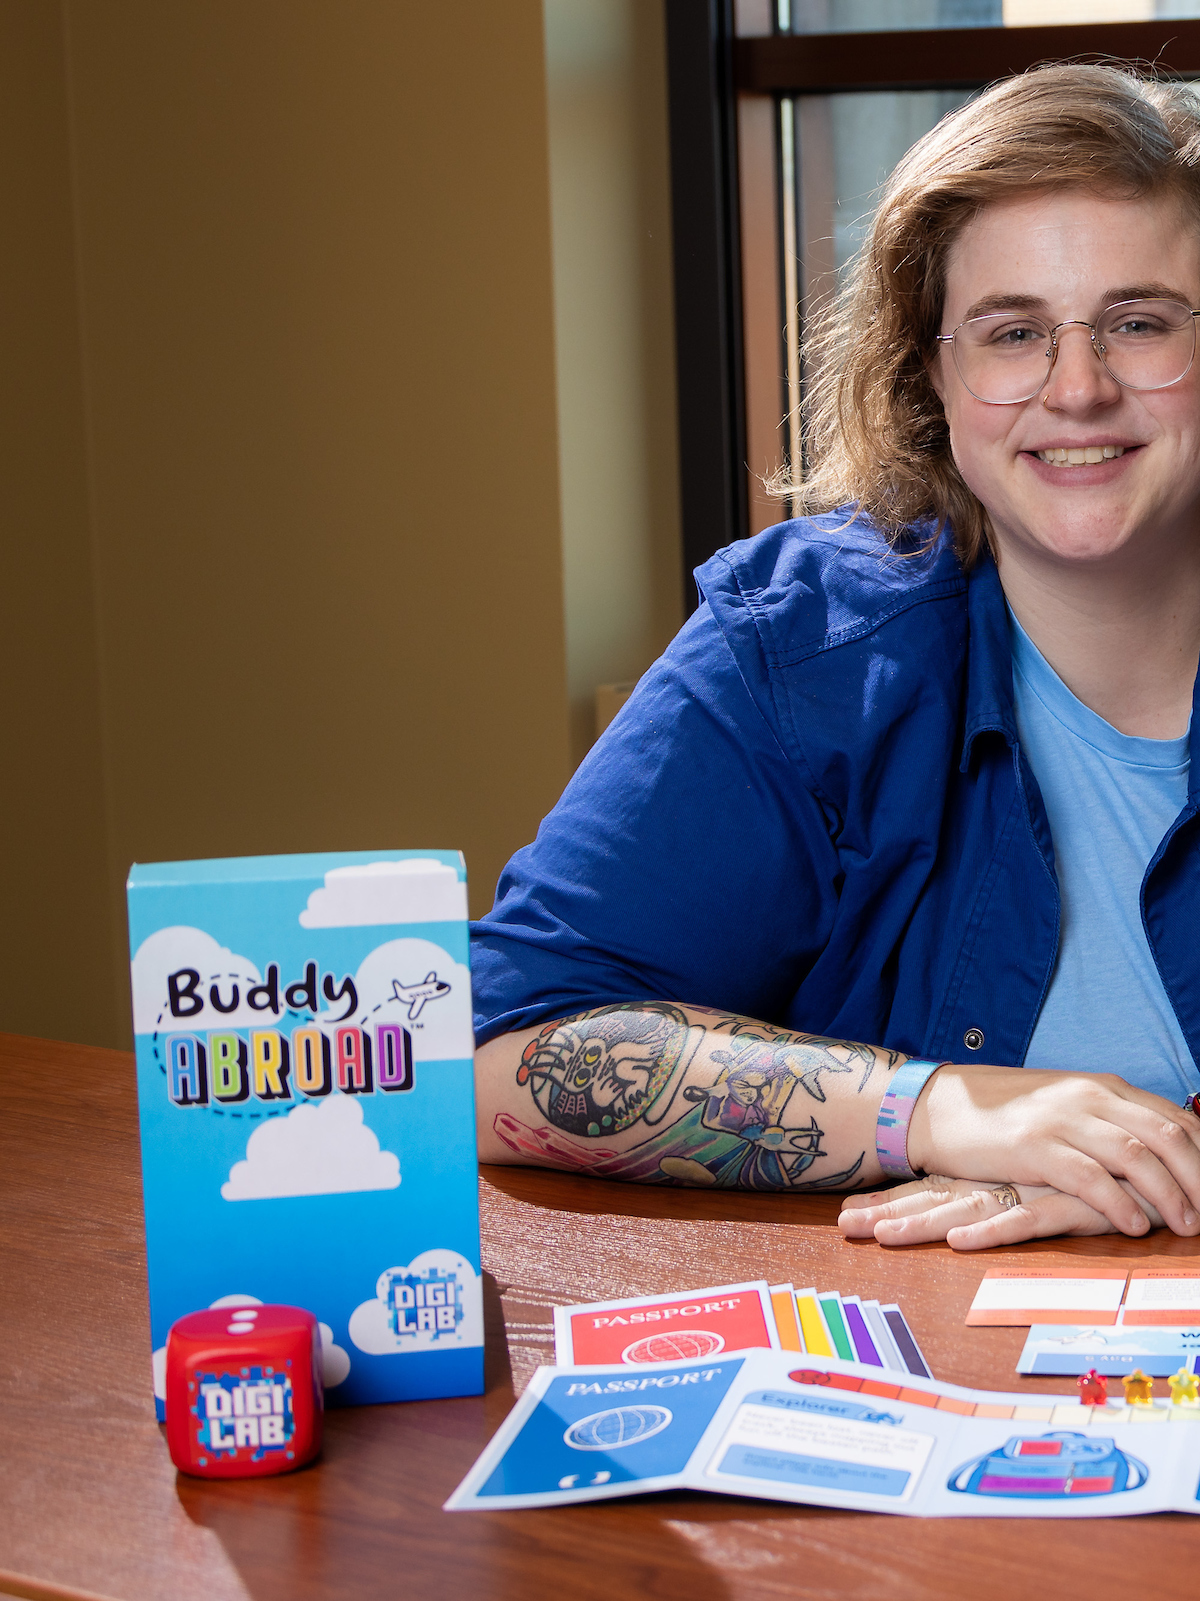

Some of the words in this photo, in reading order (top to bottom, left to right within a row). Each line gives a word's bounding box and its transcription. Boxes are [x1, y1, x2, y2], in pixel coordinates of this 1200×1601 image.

[168, 961, 359, 1023] Buddy
[167, 1024, 414, 1107] ABROAD
[394, 1282, 456, 1308] DIGI
[397, 1306, 456, 1333] LAB
[592, 1298, 740, 1329] PASSPORT
[566, 1367, 722, 1397] PASSPORT
[205, 1384, 285, 1417] DIGI
[761, 1392, 849, 1416] Explorer
[210, 1415, 285, 1449] LAB
